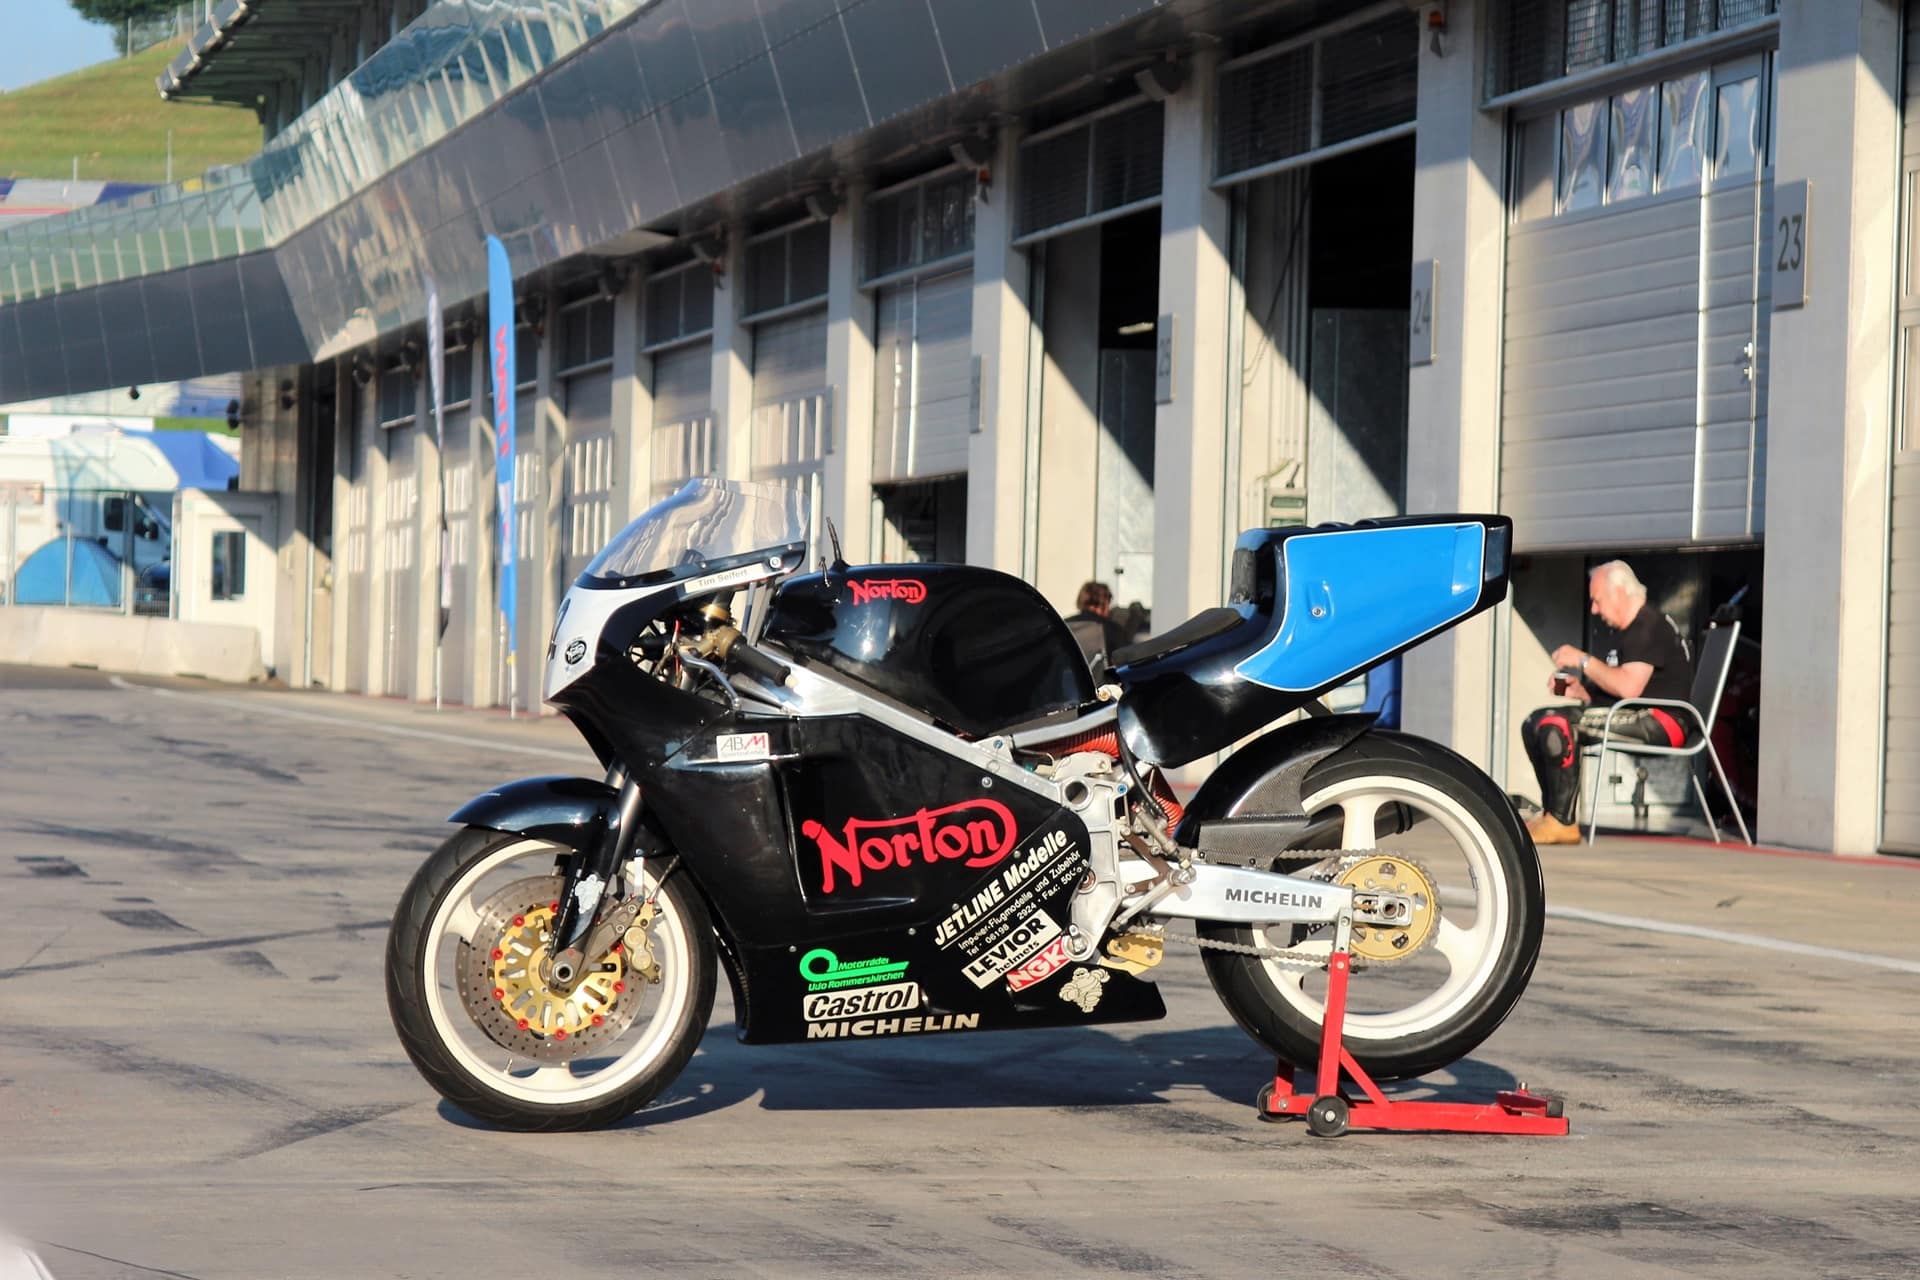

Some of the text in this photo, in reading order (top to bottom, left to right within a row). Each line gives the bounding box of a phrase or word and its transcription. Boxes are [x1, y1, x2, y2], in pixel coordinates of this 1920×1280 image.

[1777, 214, 1803, 272] 23
[699, 569, 748, 587] Tim Seifert
[846, 579, 927, 606] Norton
[720, 735, 766, 751] ABM
[802, 799, 1018, 894] Norton
[934, 830, 1068, 946] JETLINE Modelle
[1035, 876, 1050, 893] und
[1048, 850, 1081, 879] Zubehör
[1225, 888, 1323, 909] MICHELIN
[968, 917, 1047, 978] LEVIOR
[995, 940, 1040, 975] helmets
[1007, 944, 1068, 988] NGK
[807, 985, 914, 1018] Castrol
[808, 982, 828, 992] Udo
[806, 1013, 980, 1039] MICHELIN
